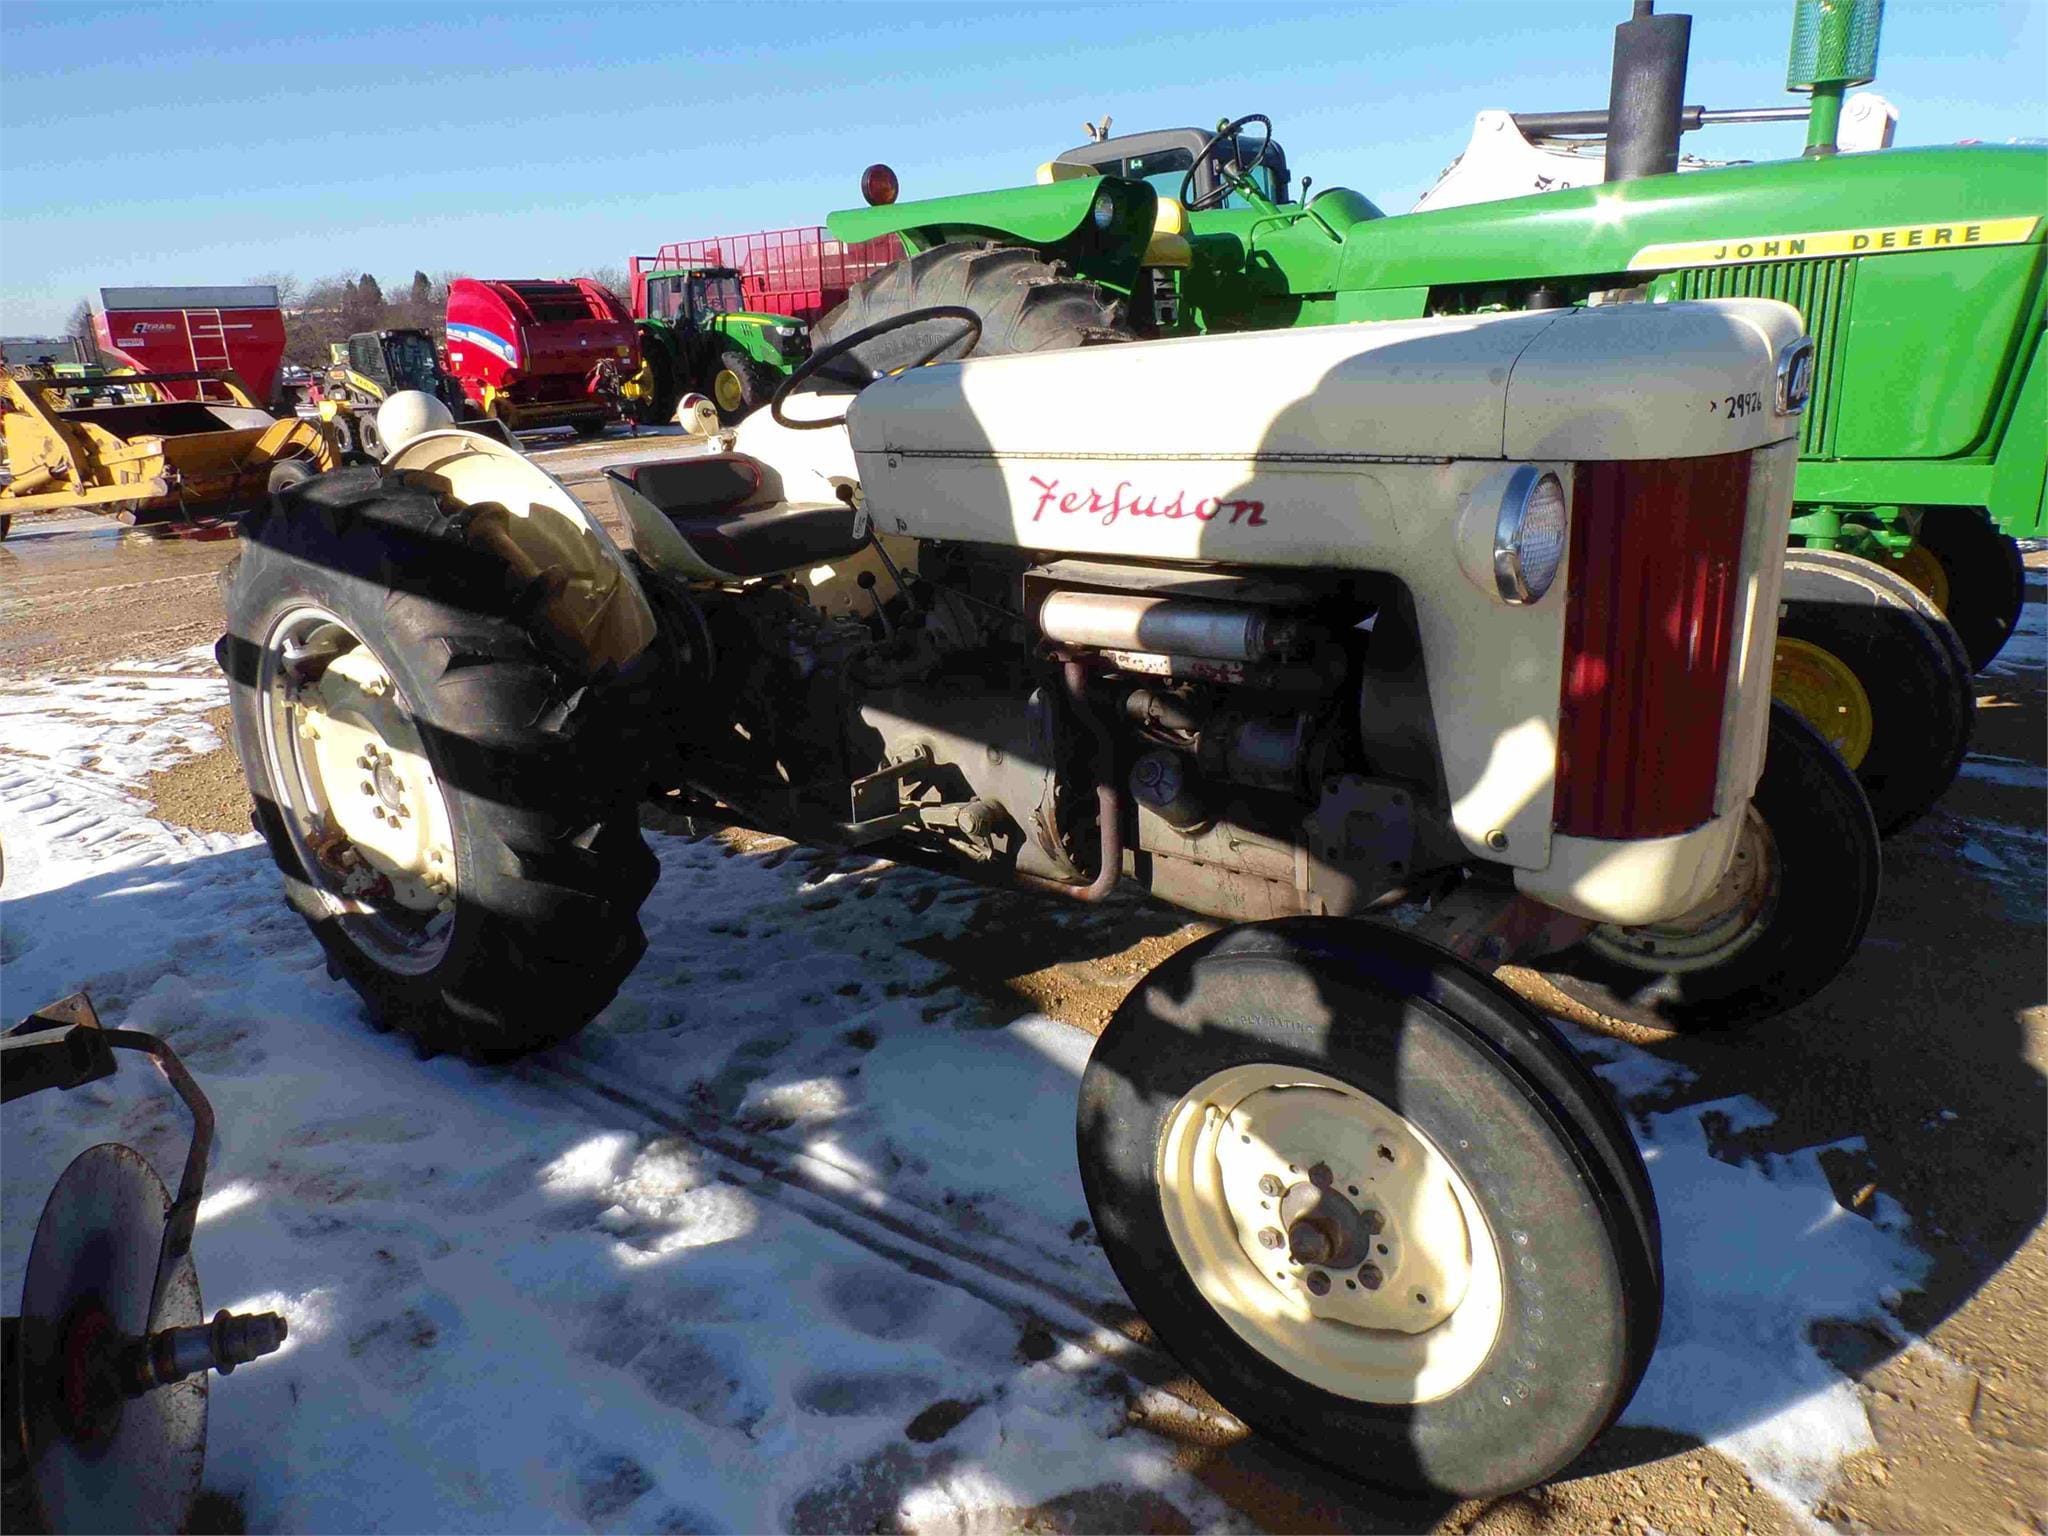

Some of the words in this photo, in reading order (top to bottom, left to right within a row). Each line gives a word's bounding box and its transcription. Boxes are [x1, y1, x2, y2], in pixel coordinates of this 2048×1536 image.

[1714, 239, 1805, 260] JOHN
[1853, 225, 1981, 250] DEERE
[1029, 475, 1267, 526] Ferguson
